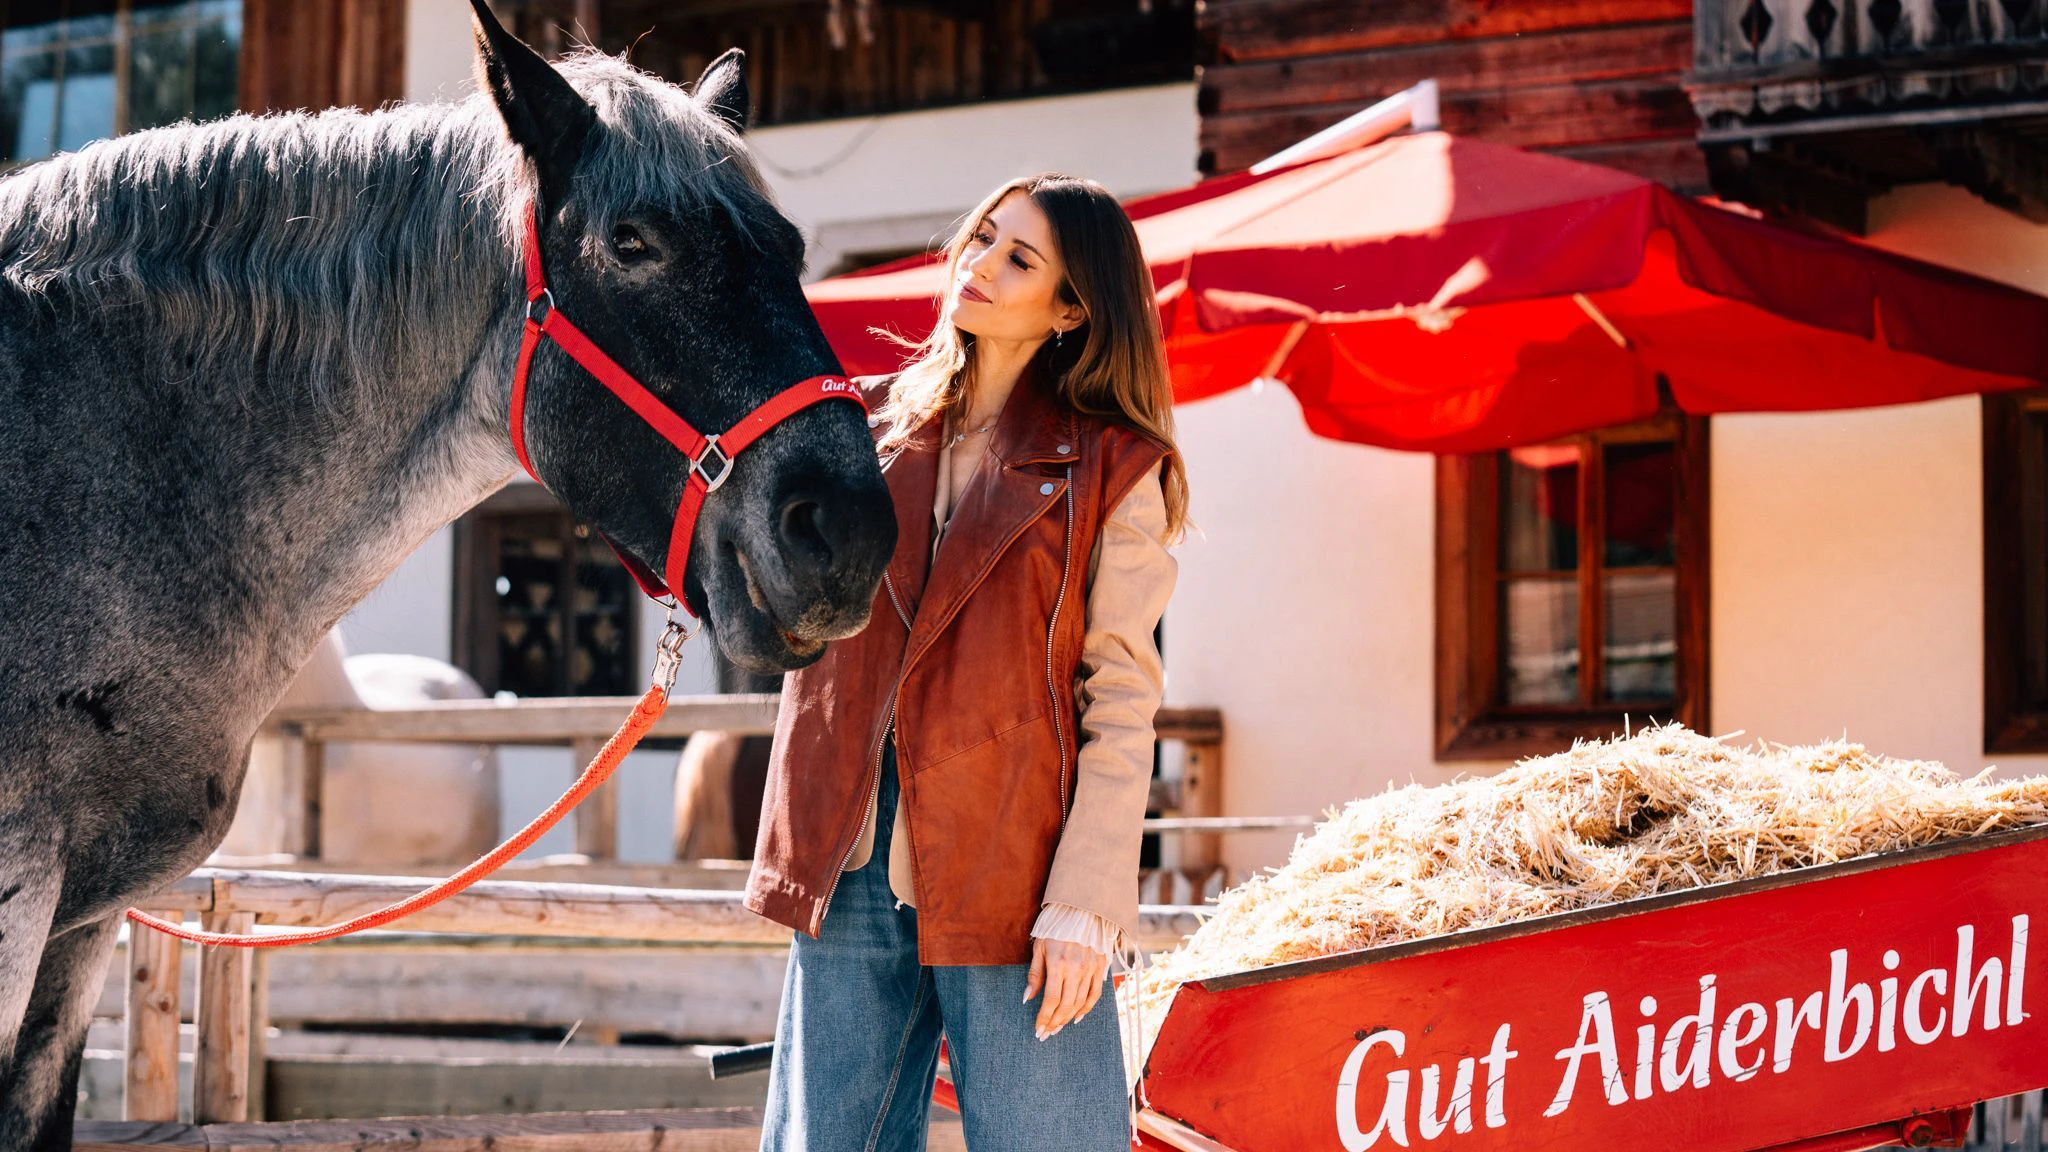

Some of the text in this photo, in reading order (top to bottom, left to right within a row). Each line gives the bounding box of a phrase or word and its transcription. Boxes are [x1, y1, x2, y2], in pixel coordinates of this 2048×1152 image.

[821, 378, 847, 392] Gut
[1336, 913, 2031, 1152] Gut Aiderbichl
